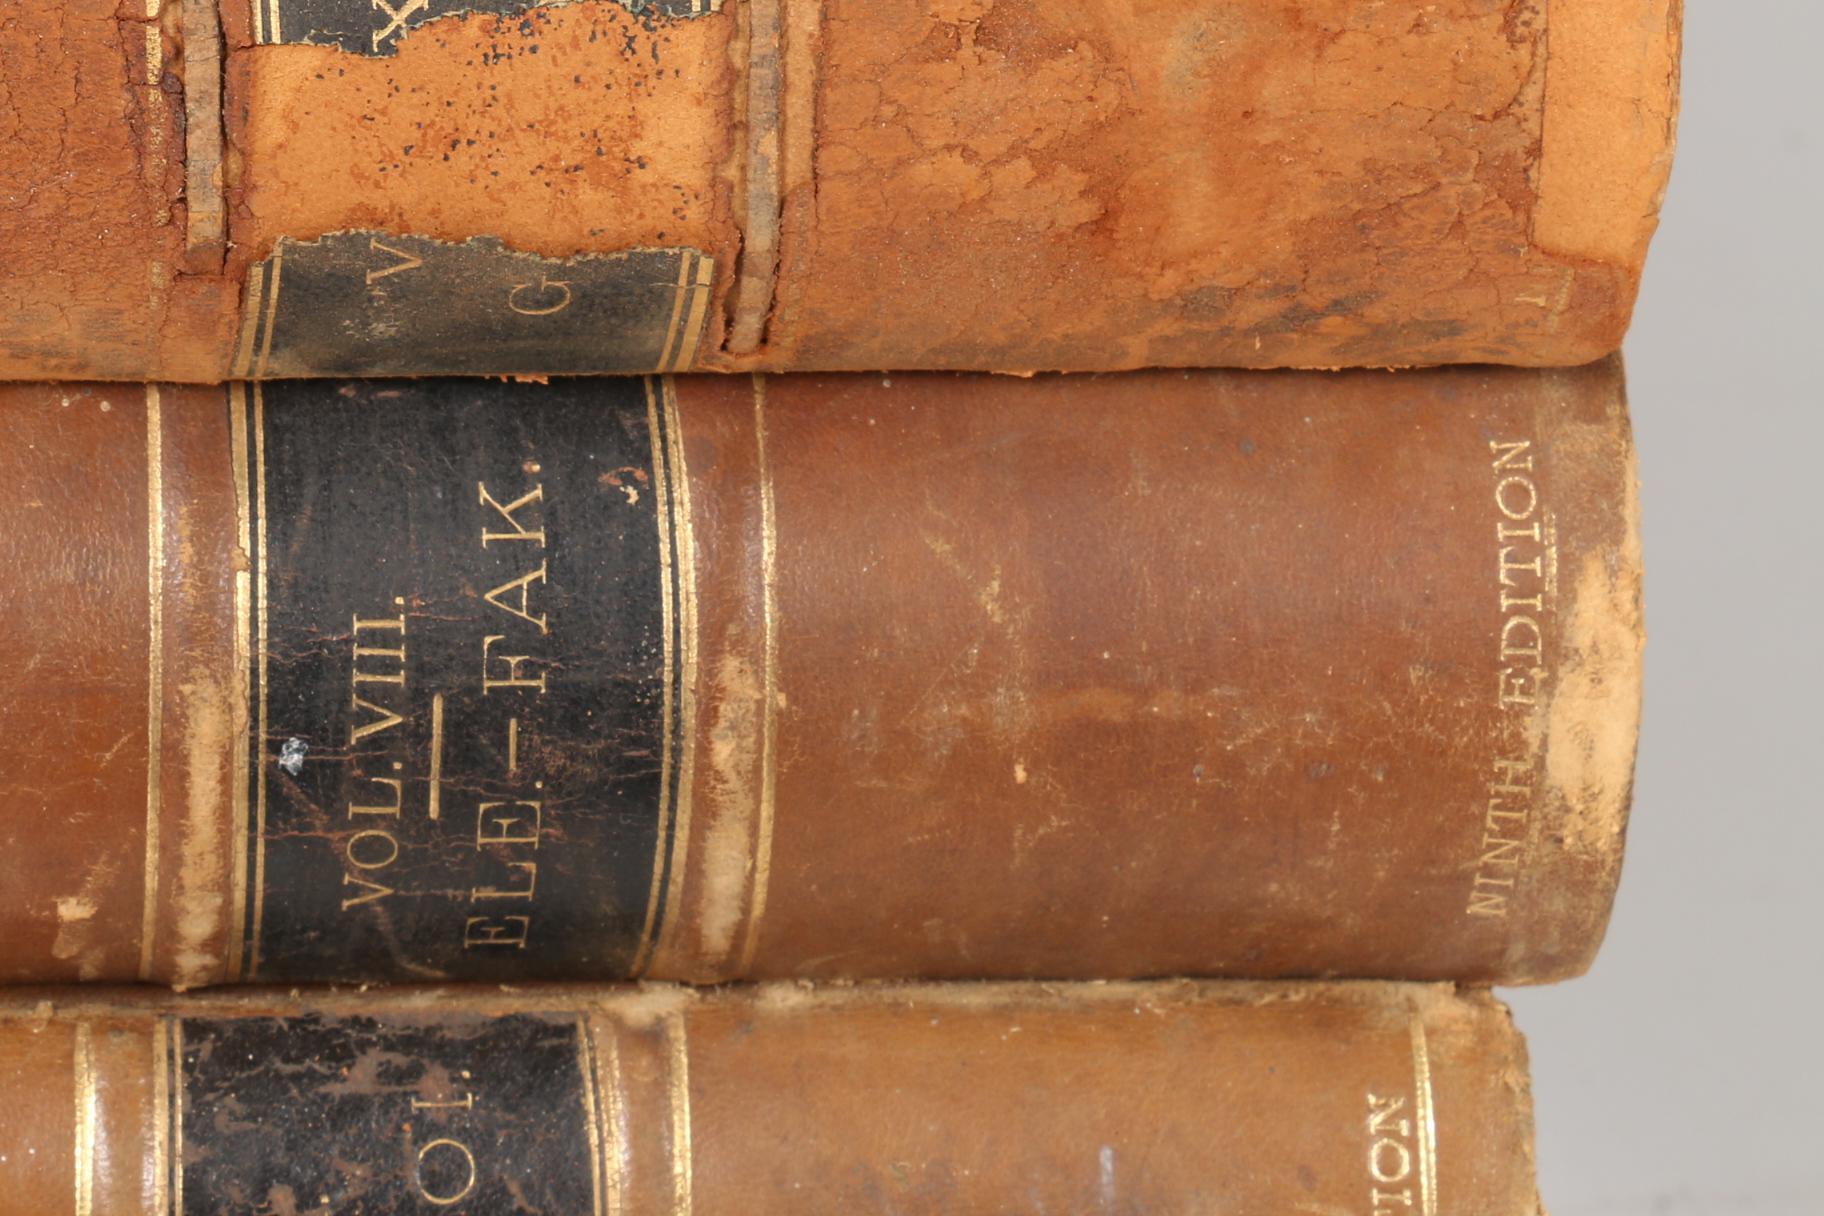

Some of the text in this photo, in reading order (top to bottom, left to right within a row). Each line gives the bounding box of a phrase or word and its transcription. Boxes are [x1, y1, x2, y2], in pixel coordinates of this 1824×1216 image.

[1466, 440, 1544, 918] NINTH EDITION
[1366, 1092, 1413, 1216] ION
